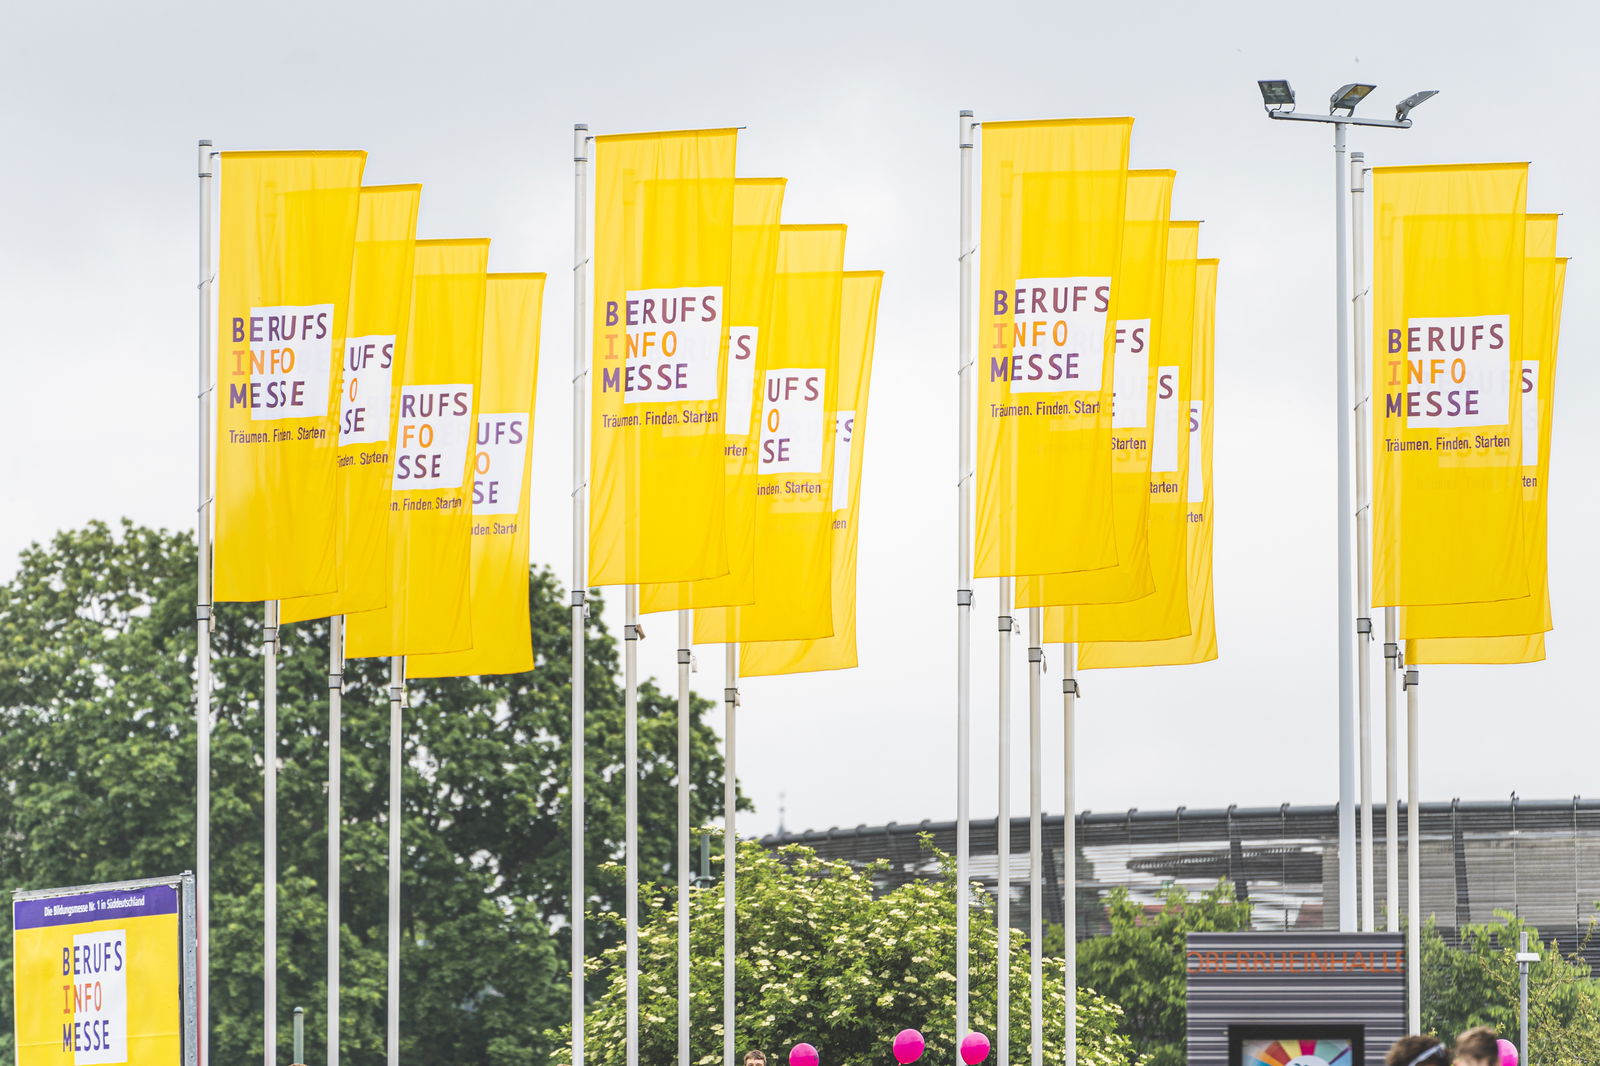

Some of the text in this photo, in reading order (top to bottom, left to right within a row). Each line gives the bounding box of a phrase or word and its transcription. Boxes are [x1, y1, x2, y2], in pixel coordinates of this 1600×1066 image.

[606, 296, 717, 326] BERUFS
[994, 286, 1110, 316] BERUFS
[232, 312, 327, 342] BERUFS
[992, 320, 1068, 349] INFO
[1388, 324, 1504, 354] BERUFS
[344, 344, 393, 371] UFS
[604, 331, 677, 360] INFO
[232, 348, 295, 375] INFO
[990, 353, 1079, 382] MESSE
[1388, 358, 1466, 386] INFO
[602, 363, 688, 392] MESSE
[768, 376, 819, 402] UFS
[229, 381, 305, 408] MESSE
[402, 392, 468, 418] RUFS
[1036, 401, 1070, 415] Finden.
[1074, 400, 1100, 414] Start
[1386, 390, 1479, 418] MESSE
[476, 420, 523, 445] UFS
[602, 410, 718, 428] Träumen. Finden. Starten
[229, 430, 270, 444] Träumen.
[297, 427, 326, 440] Starten
[1386, 435, 1510, 452] Träumen. Finden. Starten
[757, 481, 821, 496] inden. Starten
[1150, 481, 1178, 494] tarten
[101, 900, 106, 910] in
[107, 895, 145, 910] Süddeutschland
[63, 940, 122, 976] BERUFS
[63, 981, 102, 1014] INFO
[63, 1020, 110, 1052] MESSE
